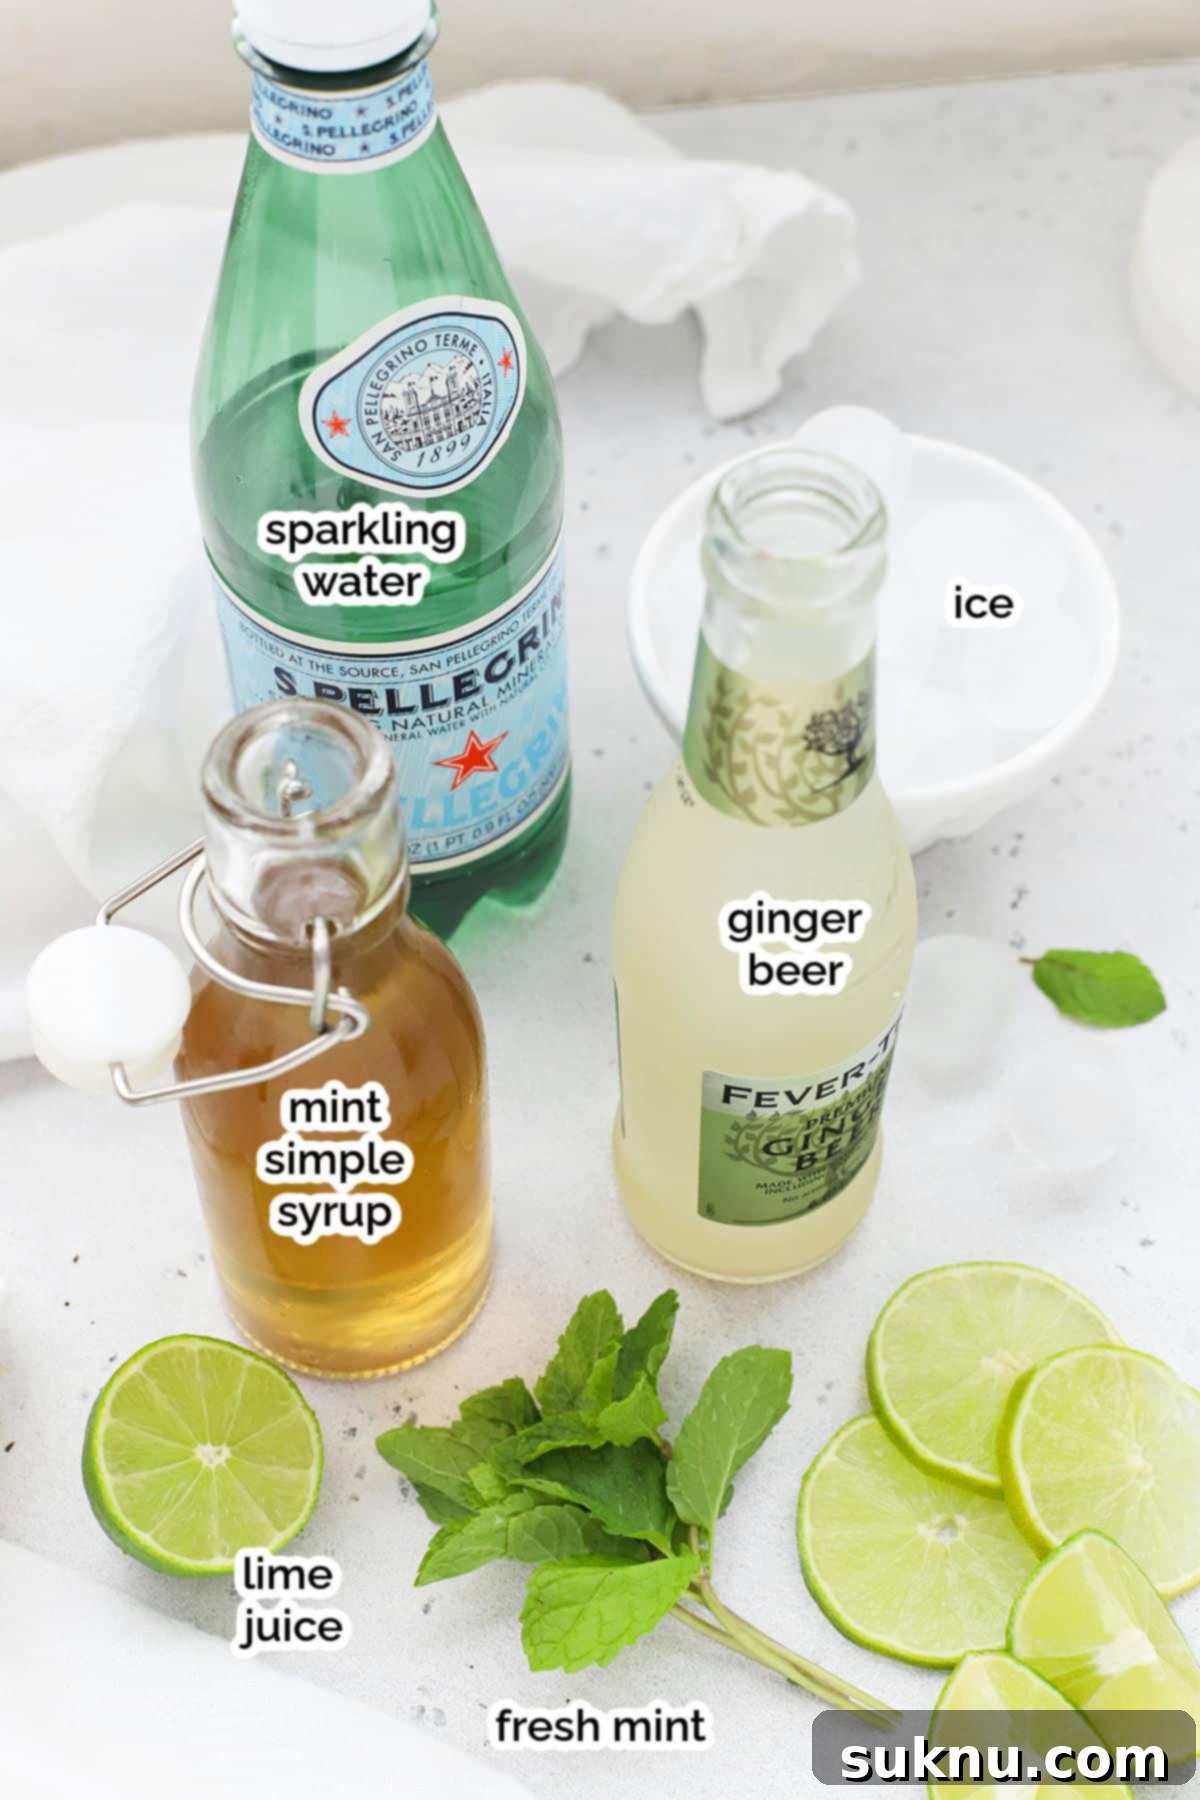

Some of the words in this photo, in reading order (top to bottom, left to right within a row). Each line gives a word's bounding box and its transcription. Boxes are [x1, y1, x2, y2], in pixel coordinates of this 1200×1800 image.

[317, 100, 418, 138] PELLEGRINO
[435, 333, 478, 358] TERME
[364, 339, 428, 426] PELLEGRINO
[477, 372, 493, 427] ITALIA
[371, 432, 402, 462] SAN
[417, 433, 471, 468] 1899
[308, 660, 334, 675] THE
[339, 666, 404, 679] SOURCE,
[409, 660, 441, 675] SAN
[446, 620, 519, 667] PELLEGRINO
[391, 695, 489, 732] NATURAL
[427, 720, 465, 737] WATER
[470, 704, 497, 723] WITH
[722, 1016, 899, 1108] FEVER-T
